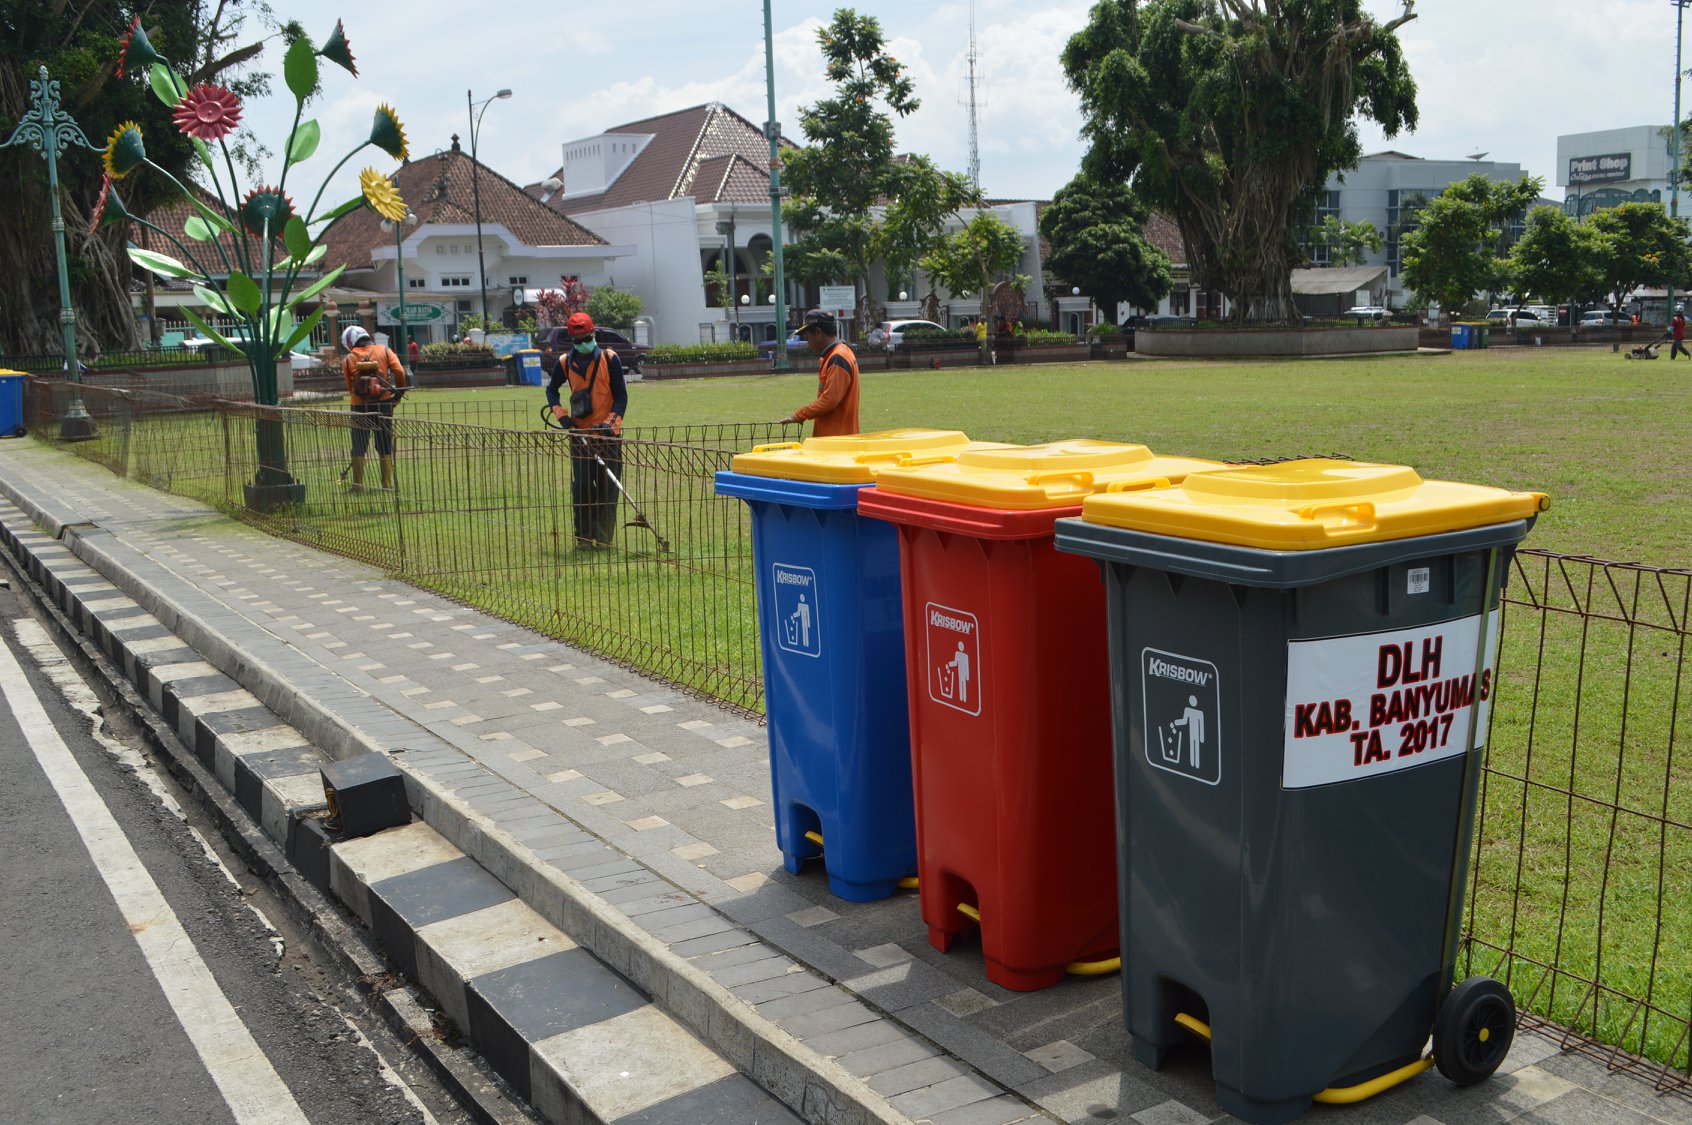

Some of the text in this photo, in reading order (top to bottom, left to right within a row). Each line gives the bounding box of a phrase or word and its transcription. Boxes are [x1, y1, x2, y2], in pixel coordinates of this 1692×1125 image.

[1571, 157, 1628, 172] Print Shop
[1149, 657, 1208, 685] KRISBOW
[1377, 635, 1443, 689] DLH
[1294, 698, 1360, 738] KAB.
[1350, 713, 1454, 766] TA. 2017
